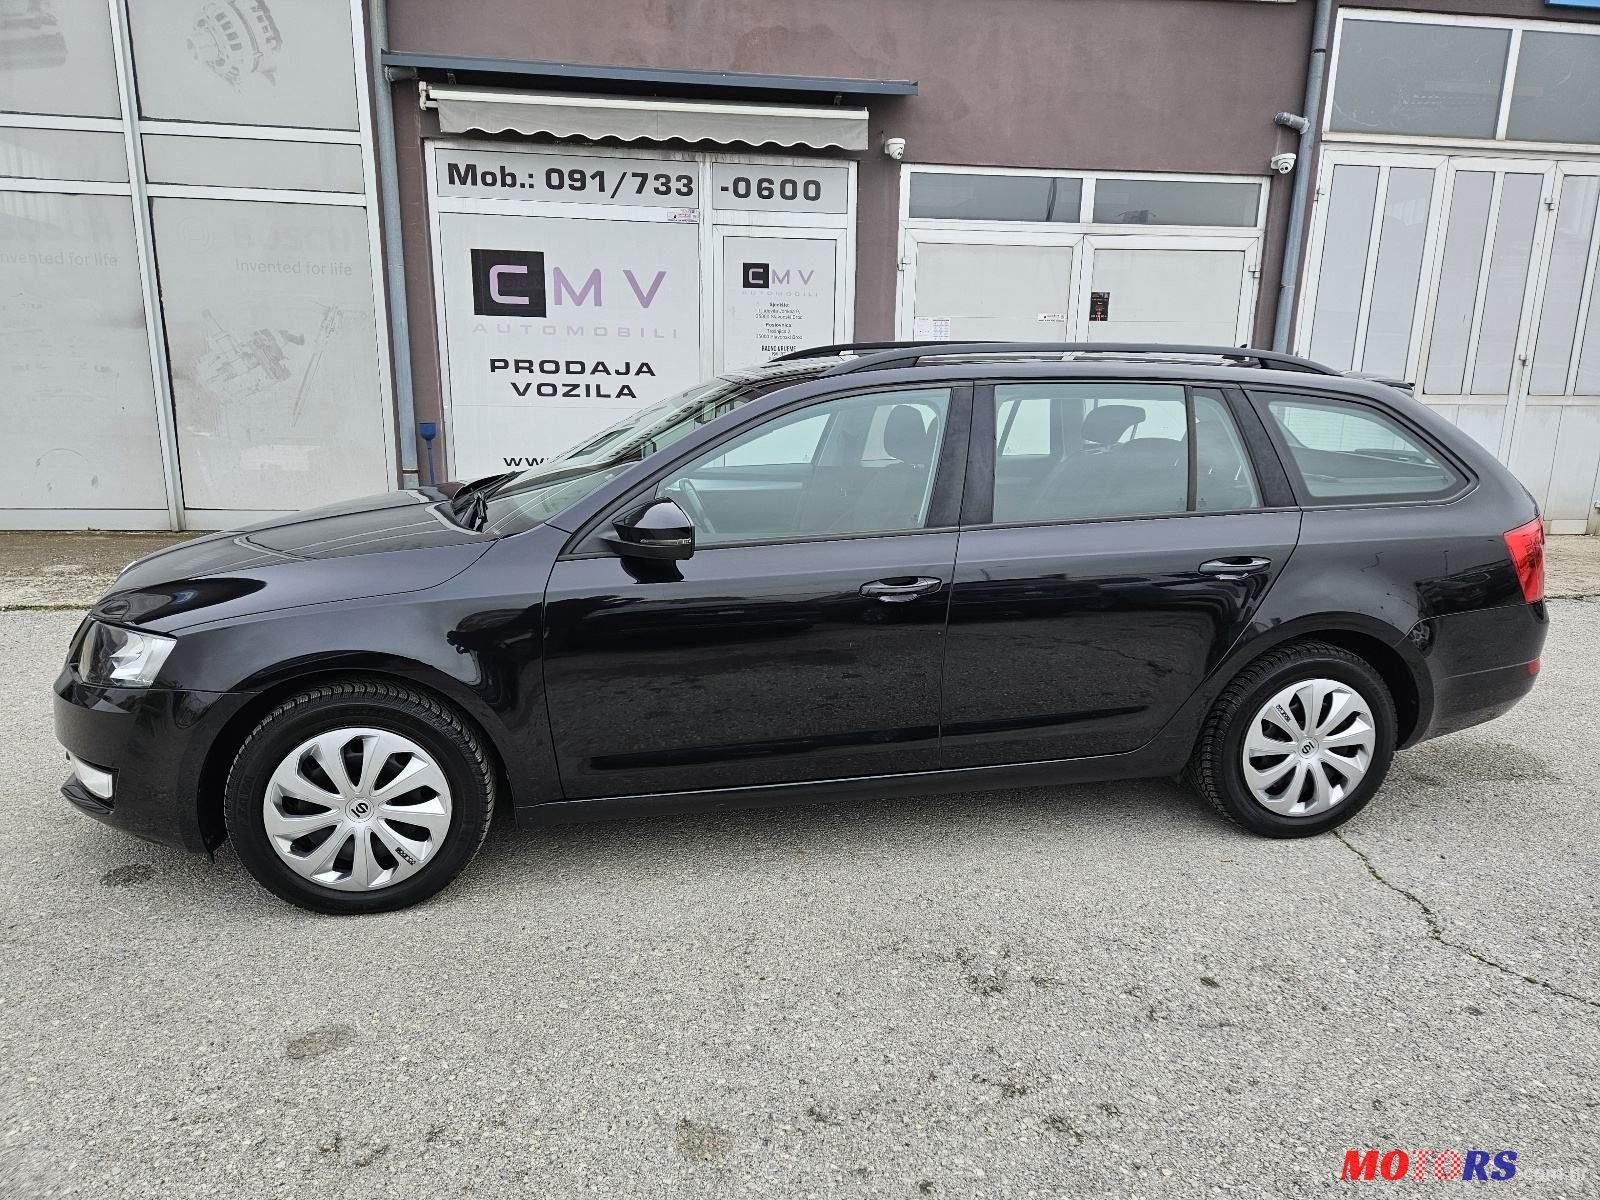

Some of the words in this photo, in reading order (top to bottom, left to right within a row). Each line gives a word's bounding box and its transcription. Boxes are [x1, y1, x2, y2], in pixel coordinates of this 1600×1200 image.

[447, 162, 535, 189] Mob.:
[545, 167, 695, 199] 091/733
[720, 175, 822, 202] -0600
[69, 252, 91, 266] for
[94, 251, 119, 267] life
[235, 258, 302, 275] Invented
[306, 261, 327, 276] for
[330, 261, 353, 277] life
[489, 264, 667, 309] CMV
[471, 323, 678, 339] AUTOMOBILI
[489, 358, 656, 377] PRODAJA
[510, 382, 637, 398] VOZILA
[503, 457, 549, 467] ww
